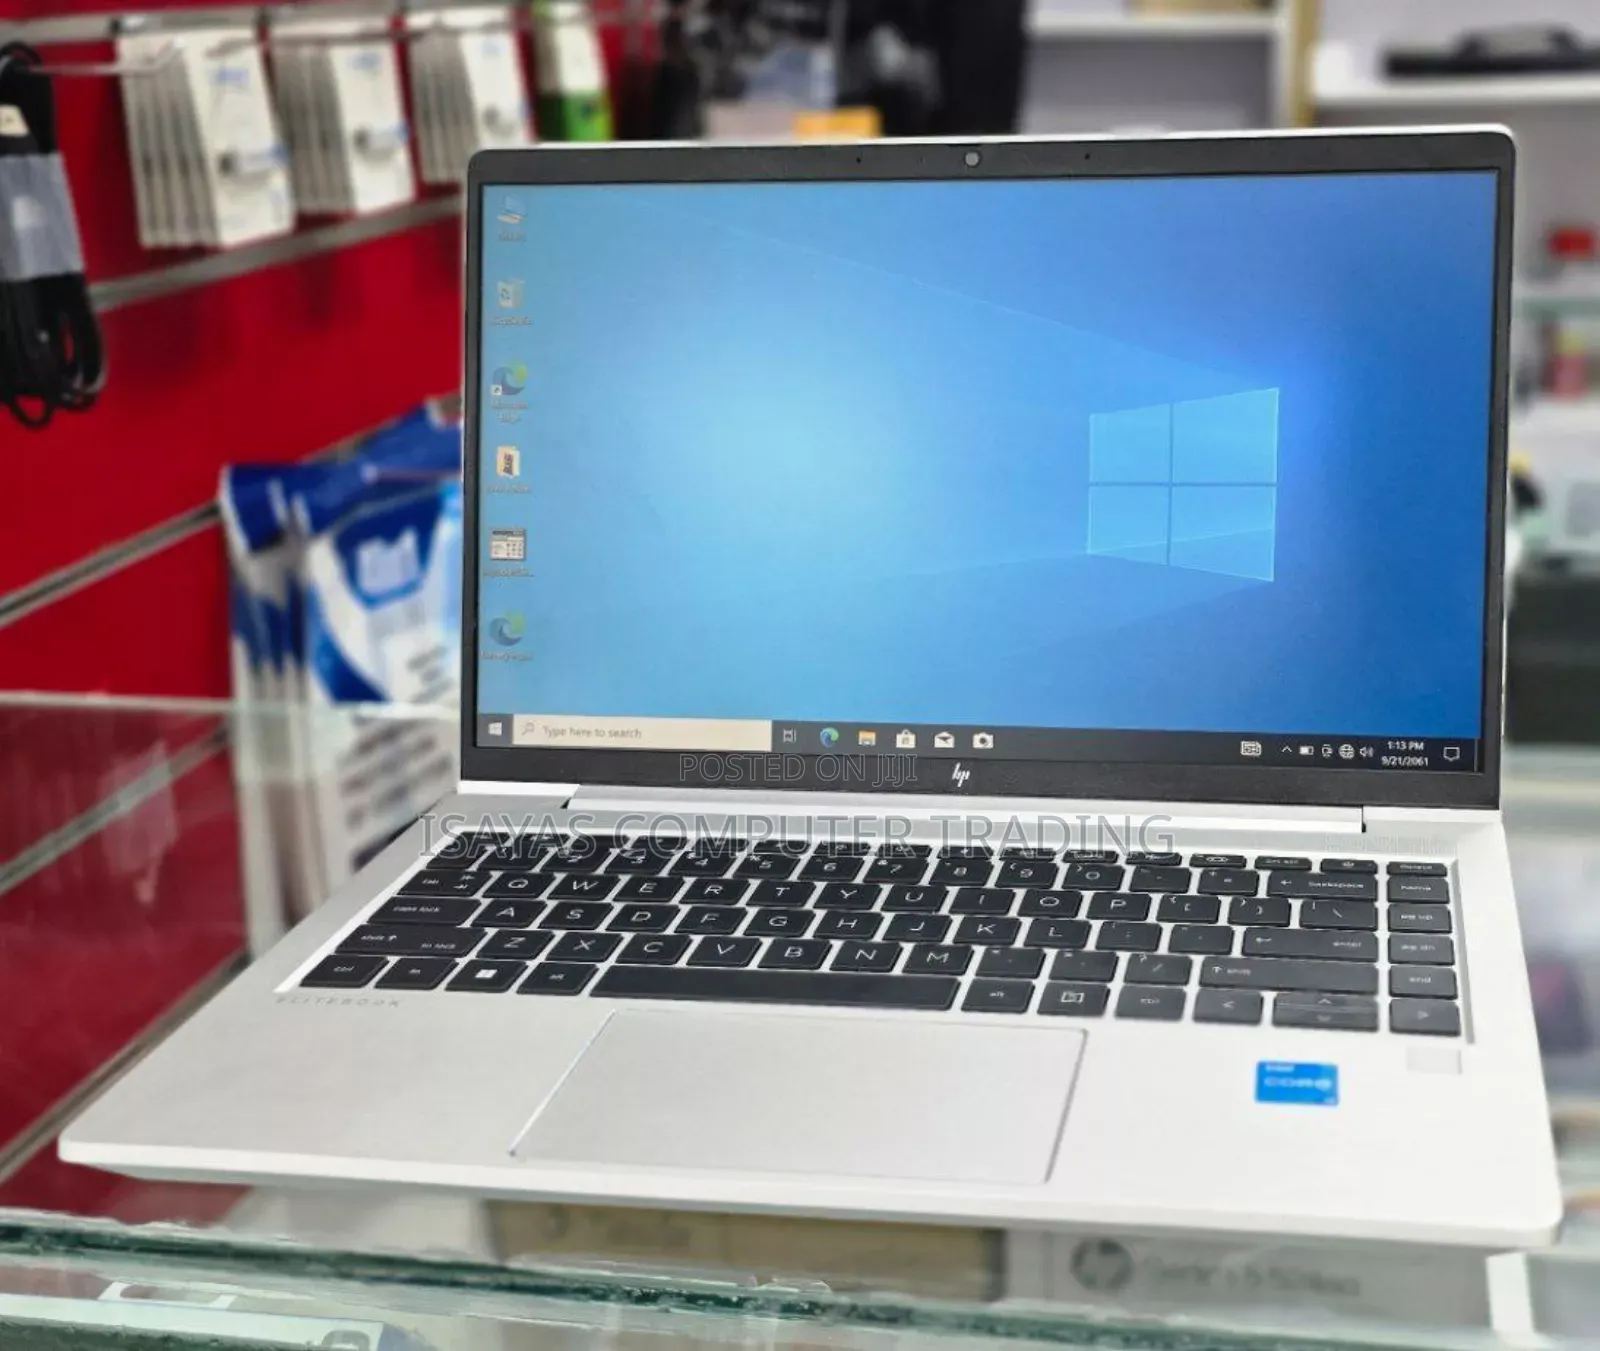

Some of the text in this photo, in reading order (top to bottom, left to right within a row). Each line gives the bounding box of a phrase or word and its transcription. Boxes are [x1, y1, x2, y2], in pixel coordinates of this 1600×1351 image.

[543, 726, 642, 739] Type here to search
[1387, 740, 1425, 751] 1:13 PM
[952, 762, 971, 788] hp
[758, 859, 773, 869] 5
[823, 862, 837, 872] 6
[508, 878, 1127, 909] Q W E R T Y U I O P
[496, 906, 1063, 937] A S D F G H J K L
[504, 937, 949, 963] Z X C V B N M
